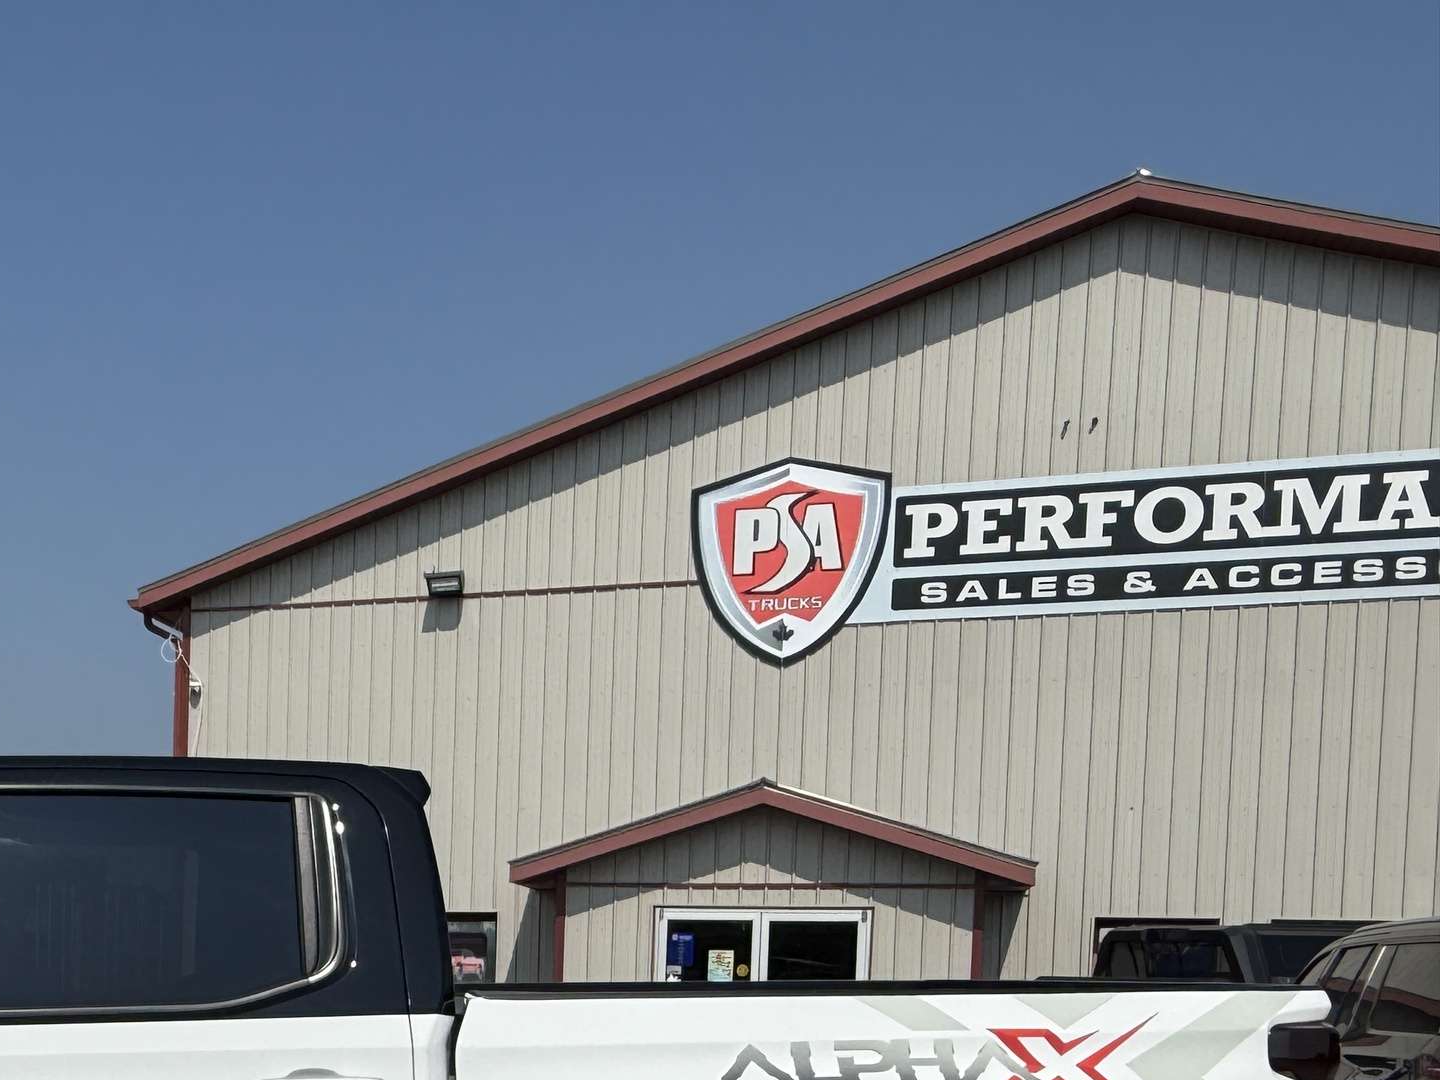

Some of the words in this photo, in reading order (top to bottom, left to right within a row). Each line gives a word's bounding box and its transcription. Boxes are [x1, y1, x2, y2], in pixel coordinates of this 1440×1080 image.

[732, 490, 845, 595] PSA
[904, 470, 1440, 558] PERFORMA
[747, 596, 823, 612] TRUCKS
[921, 574, 1095, 603] SALES
[1123, 571, 1157, 594] &
[1183, 556, 1440, 591] ACCESS
